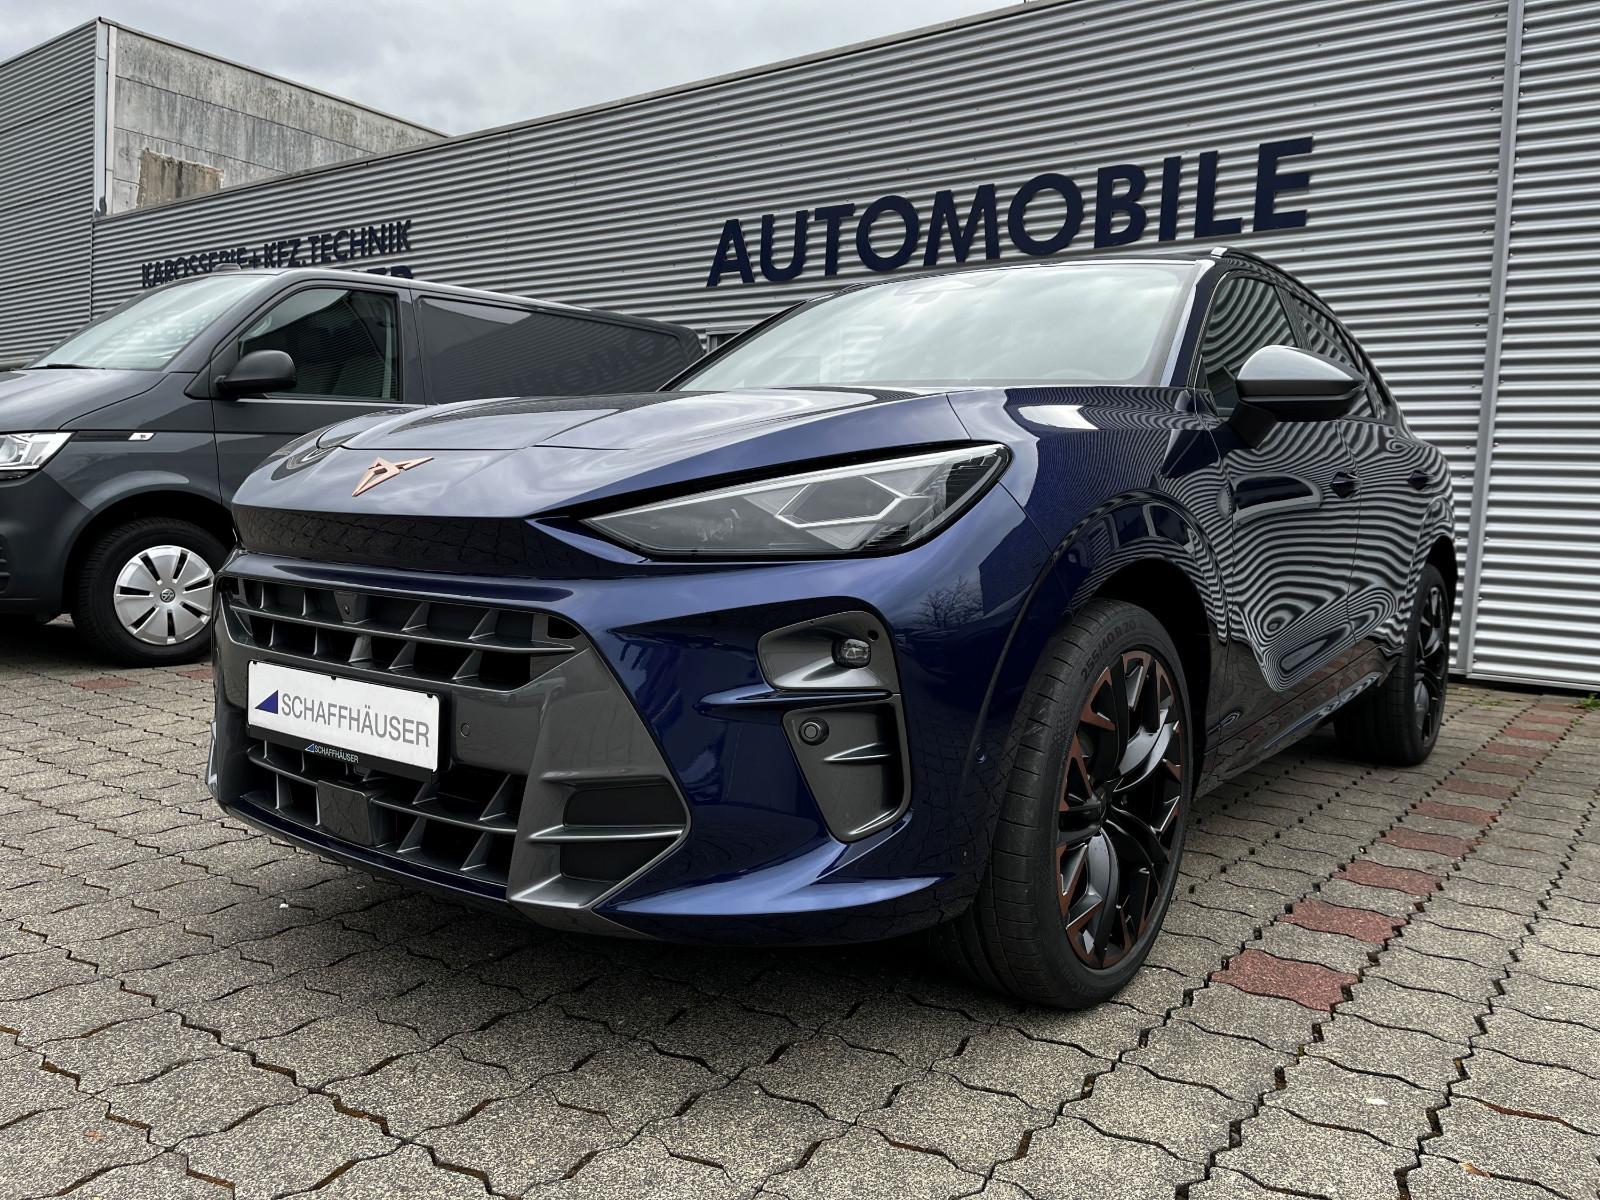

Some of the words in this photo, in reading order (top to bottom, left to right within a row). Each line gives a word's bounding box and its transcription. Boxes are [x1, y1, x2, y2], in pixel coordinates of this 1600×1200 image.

[706, 136, 1314, 287] AUTOMOBILE
[281, 692, 430, 748] SCHAFFHÄUSER
[314, 744, 359, 764] SCHAFFHÄUSER
